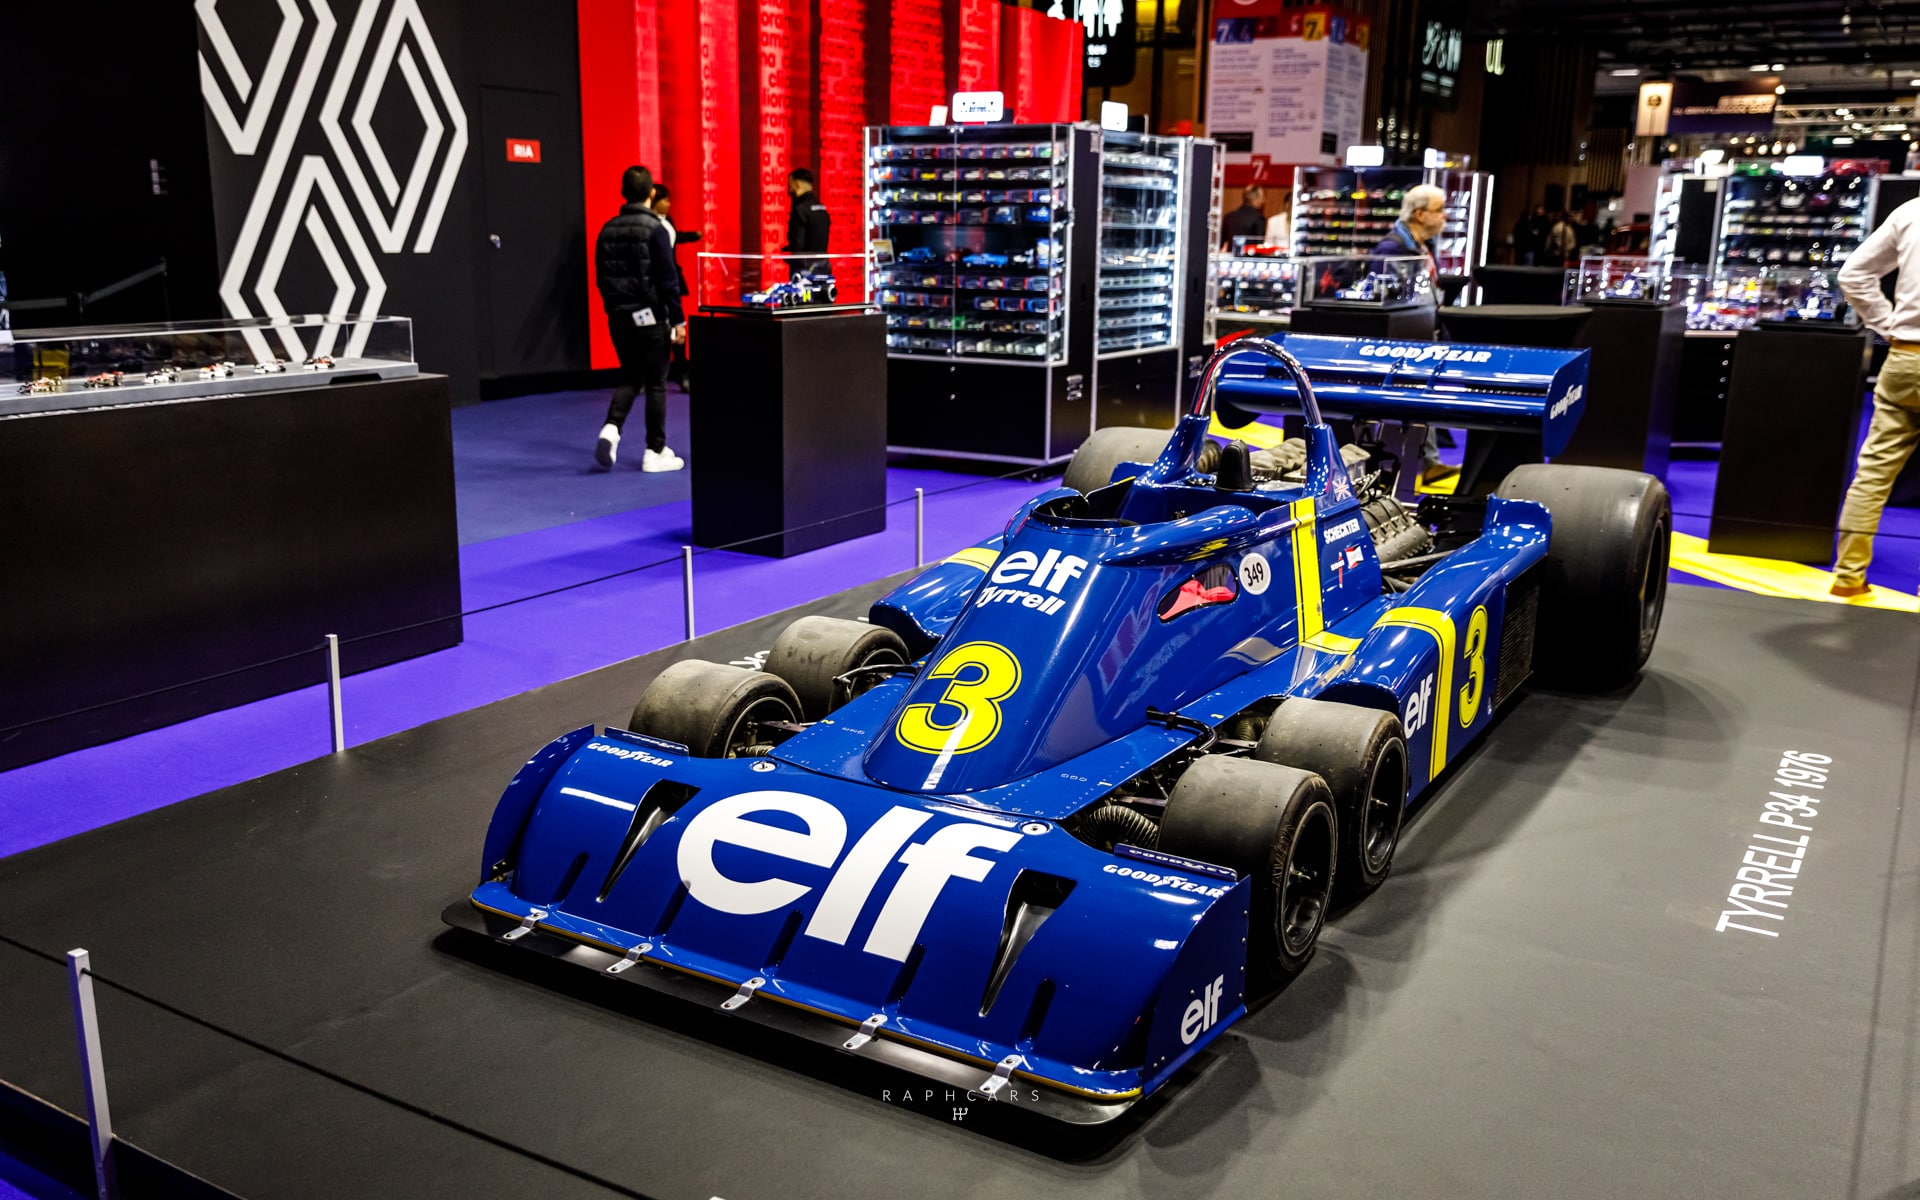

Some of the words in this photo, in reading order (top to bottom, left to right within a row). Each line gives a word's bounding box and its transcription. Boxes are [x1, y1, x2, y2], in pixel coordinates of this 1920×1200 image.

[513, 144, 534, 158] RIA
[1359, 345, 1491, 363] GOODYEAR
[1324, 518, 1361, 544] SCHECKTER
[991, 549, 1088, 594] elf
[1244, 562, 1264, 587] 349
[975, 585, 1066, 616] Tyrrell
[1459, 604, 1488, 728] 3
[895, 640, 1022, 755] 3
[1404, 672, 1433, 739] elf
[587, 742, 674, 767] GOODYEAR
[1773, 750, 1833, 790] 1976
[1759, 791, 1821, 831] P34
[677, 790, 1025, 963] elf
[1102, 864, 1227, 898] GOODYEAR
[1715, 834, 1810, 937] TYRRELL
[1181, 974, 1224, 1045] elf
